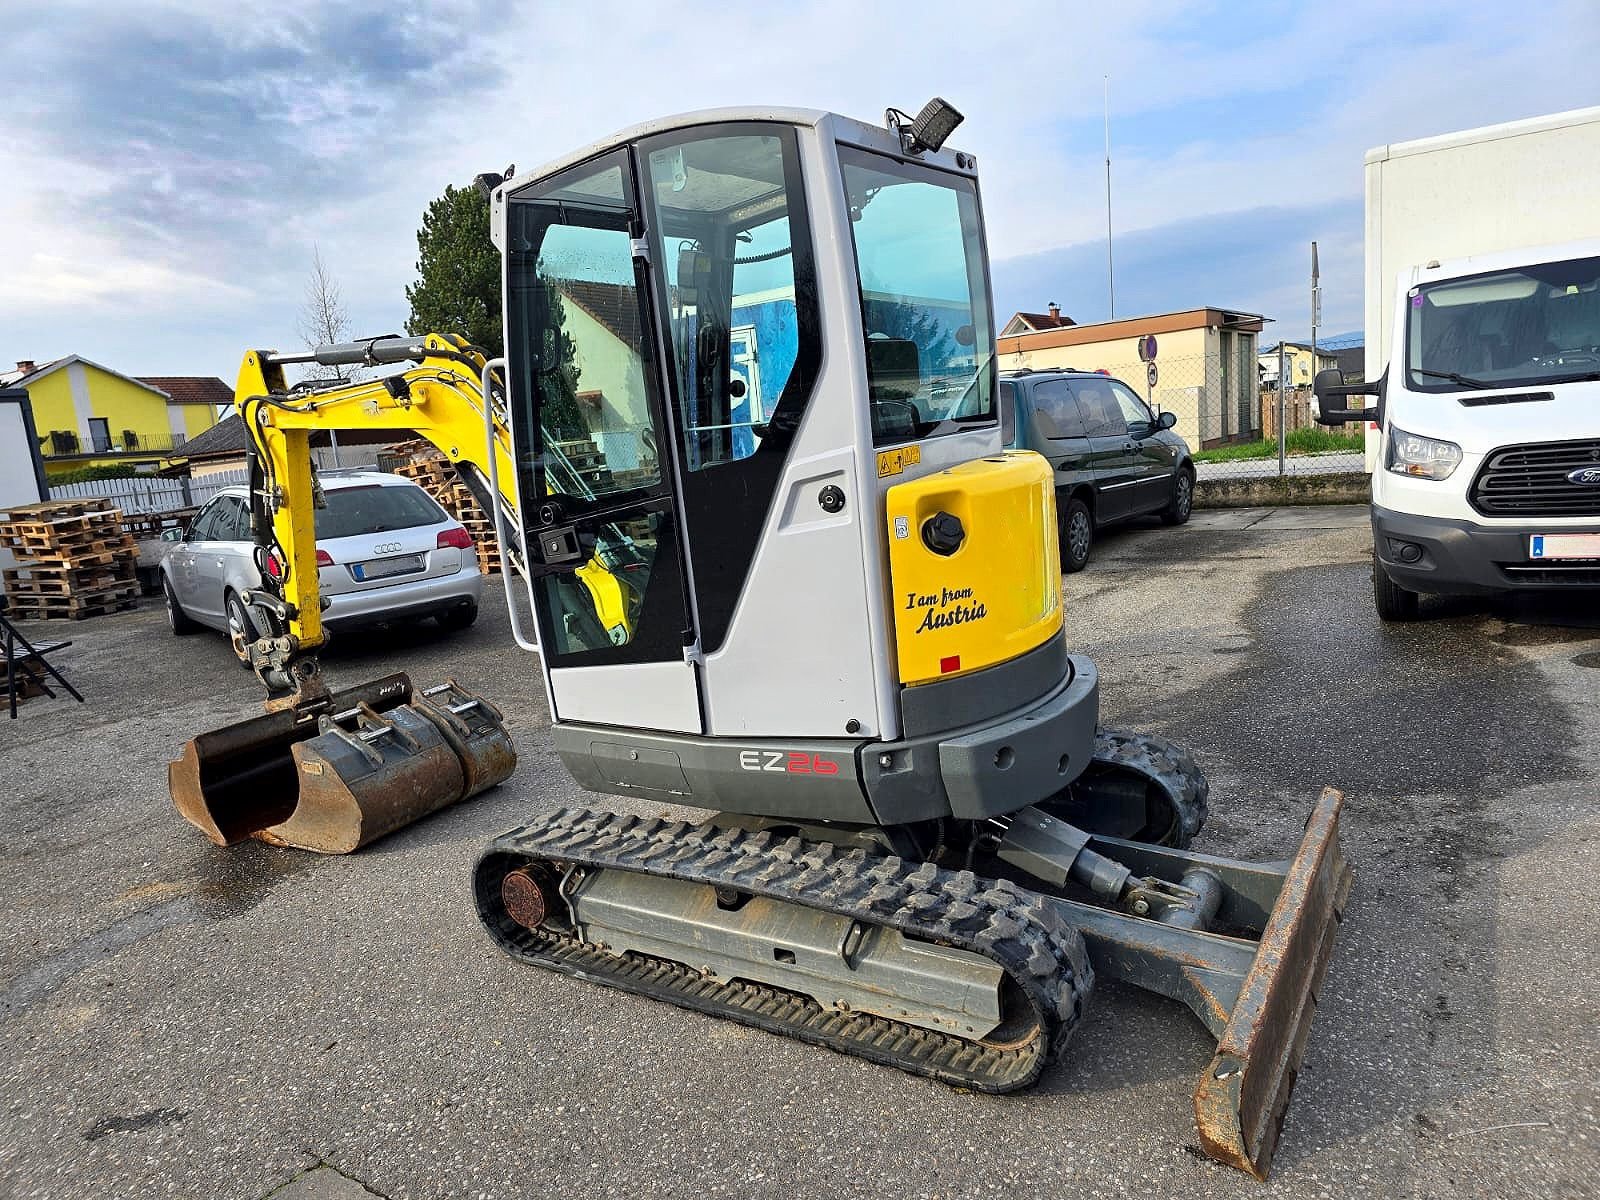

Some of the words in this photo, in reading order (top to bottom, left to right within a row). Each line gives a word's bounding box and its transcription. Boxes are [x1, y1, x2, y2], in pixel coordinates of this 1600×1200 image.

[905, 593, 916, 609] I
[917, 595, 939, 607] am
[941, 587, 973, 607] from
[916, 600, 987, 634] Austria
[740, 750, 839, 775] EZ26
